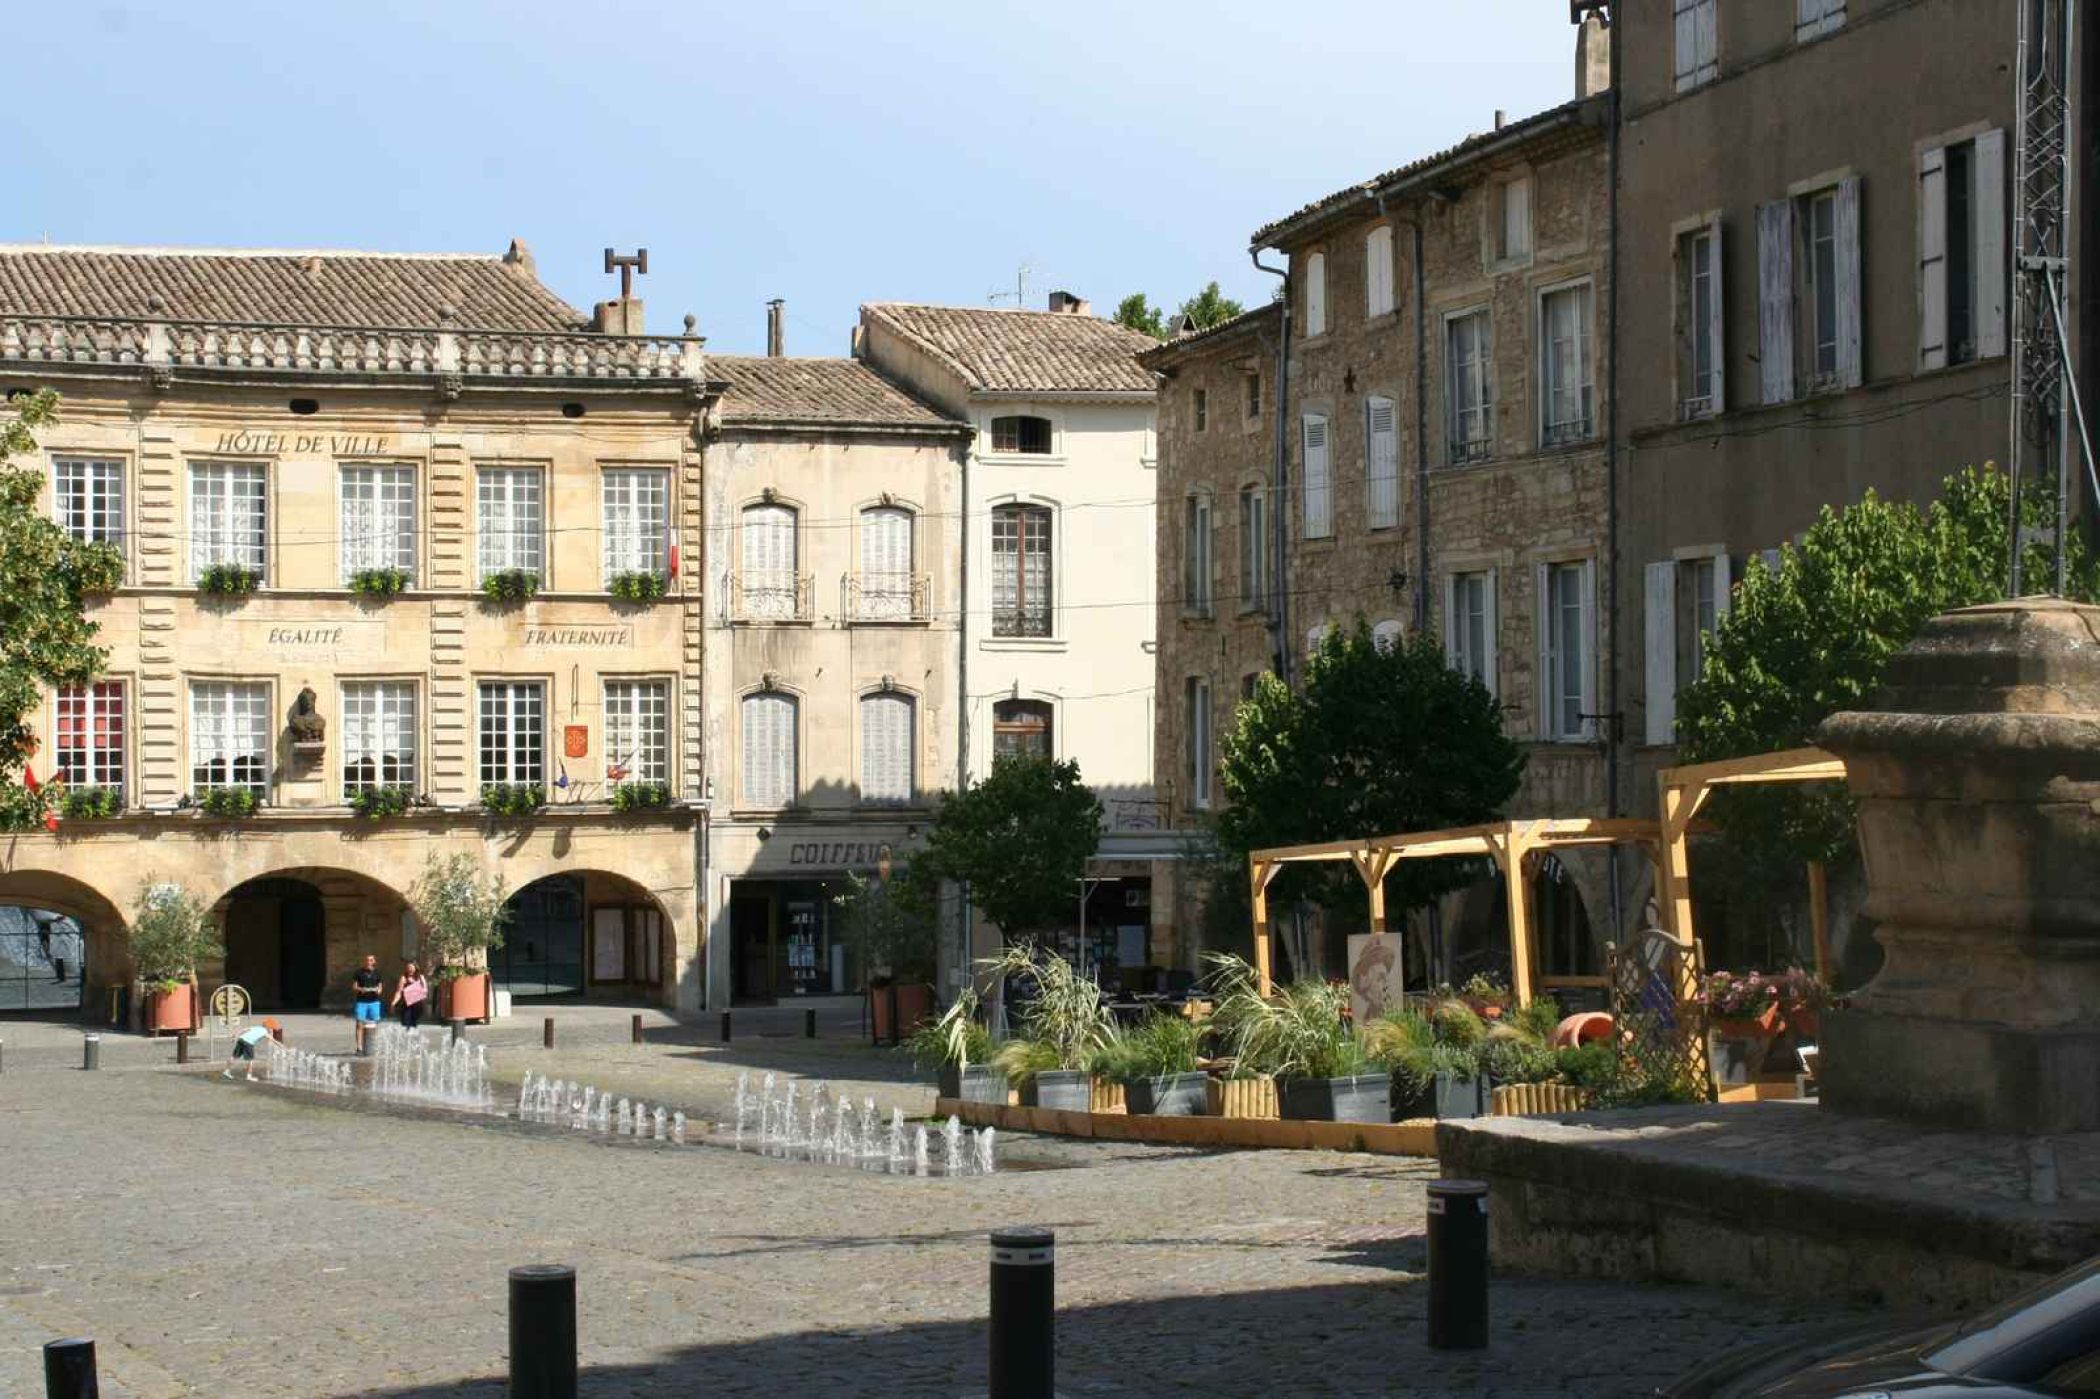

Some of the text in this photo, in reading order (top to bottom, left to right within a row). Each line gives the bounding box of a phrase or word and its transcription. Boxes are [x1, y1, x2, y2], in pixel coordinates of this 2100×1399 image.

[216, 429, 389, 454] HÔTEL DE VILLE
[268, 627, 342, 643] ÉGALITÉ
[790, 842, 892, 864] COIFFEU
